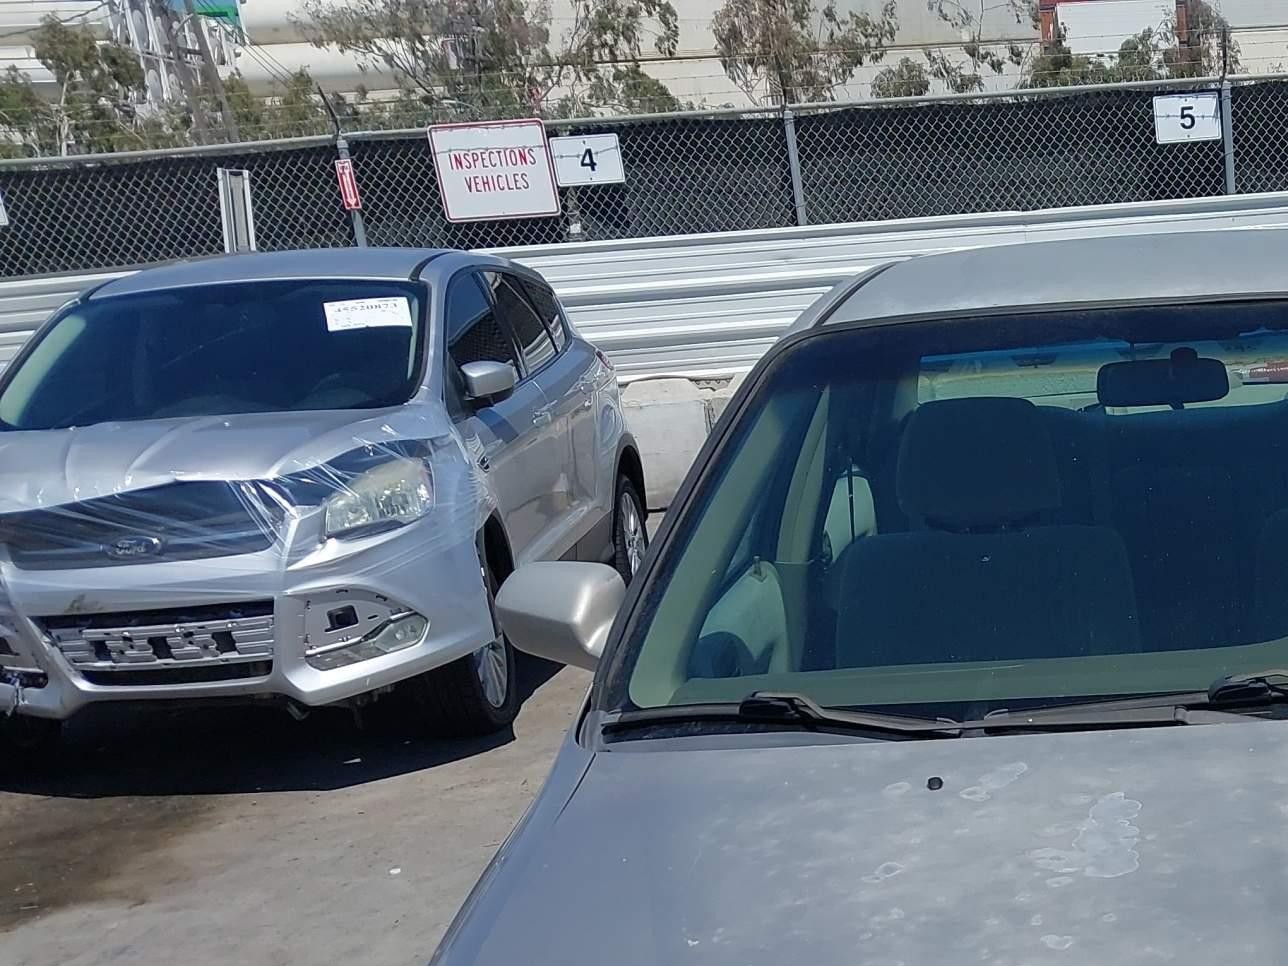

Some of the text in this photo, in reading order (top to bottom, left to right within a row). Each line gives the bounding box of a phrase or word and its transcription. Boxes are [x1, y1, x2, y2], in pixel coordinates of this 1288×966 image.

[1180, 106, 1196, 129] 5
[448, 148, 537, 170] INSPECTIONS
[579, 148, 597, 172] 4
[464, 172, 530, 193] VEHICLES
[115, 540, 146, 555] Ford
